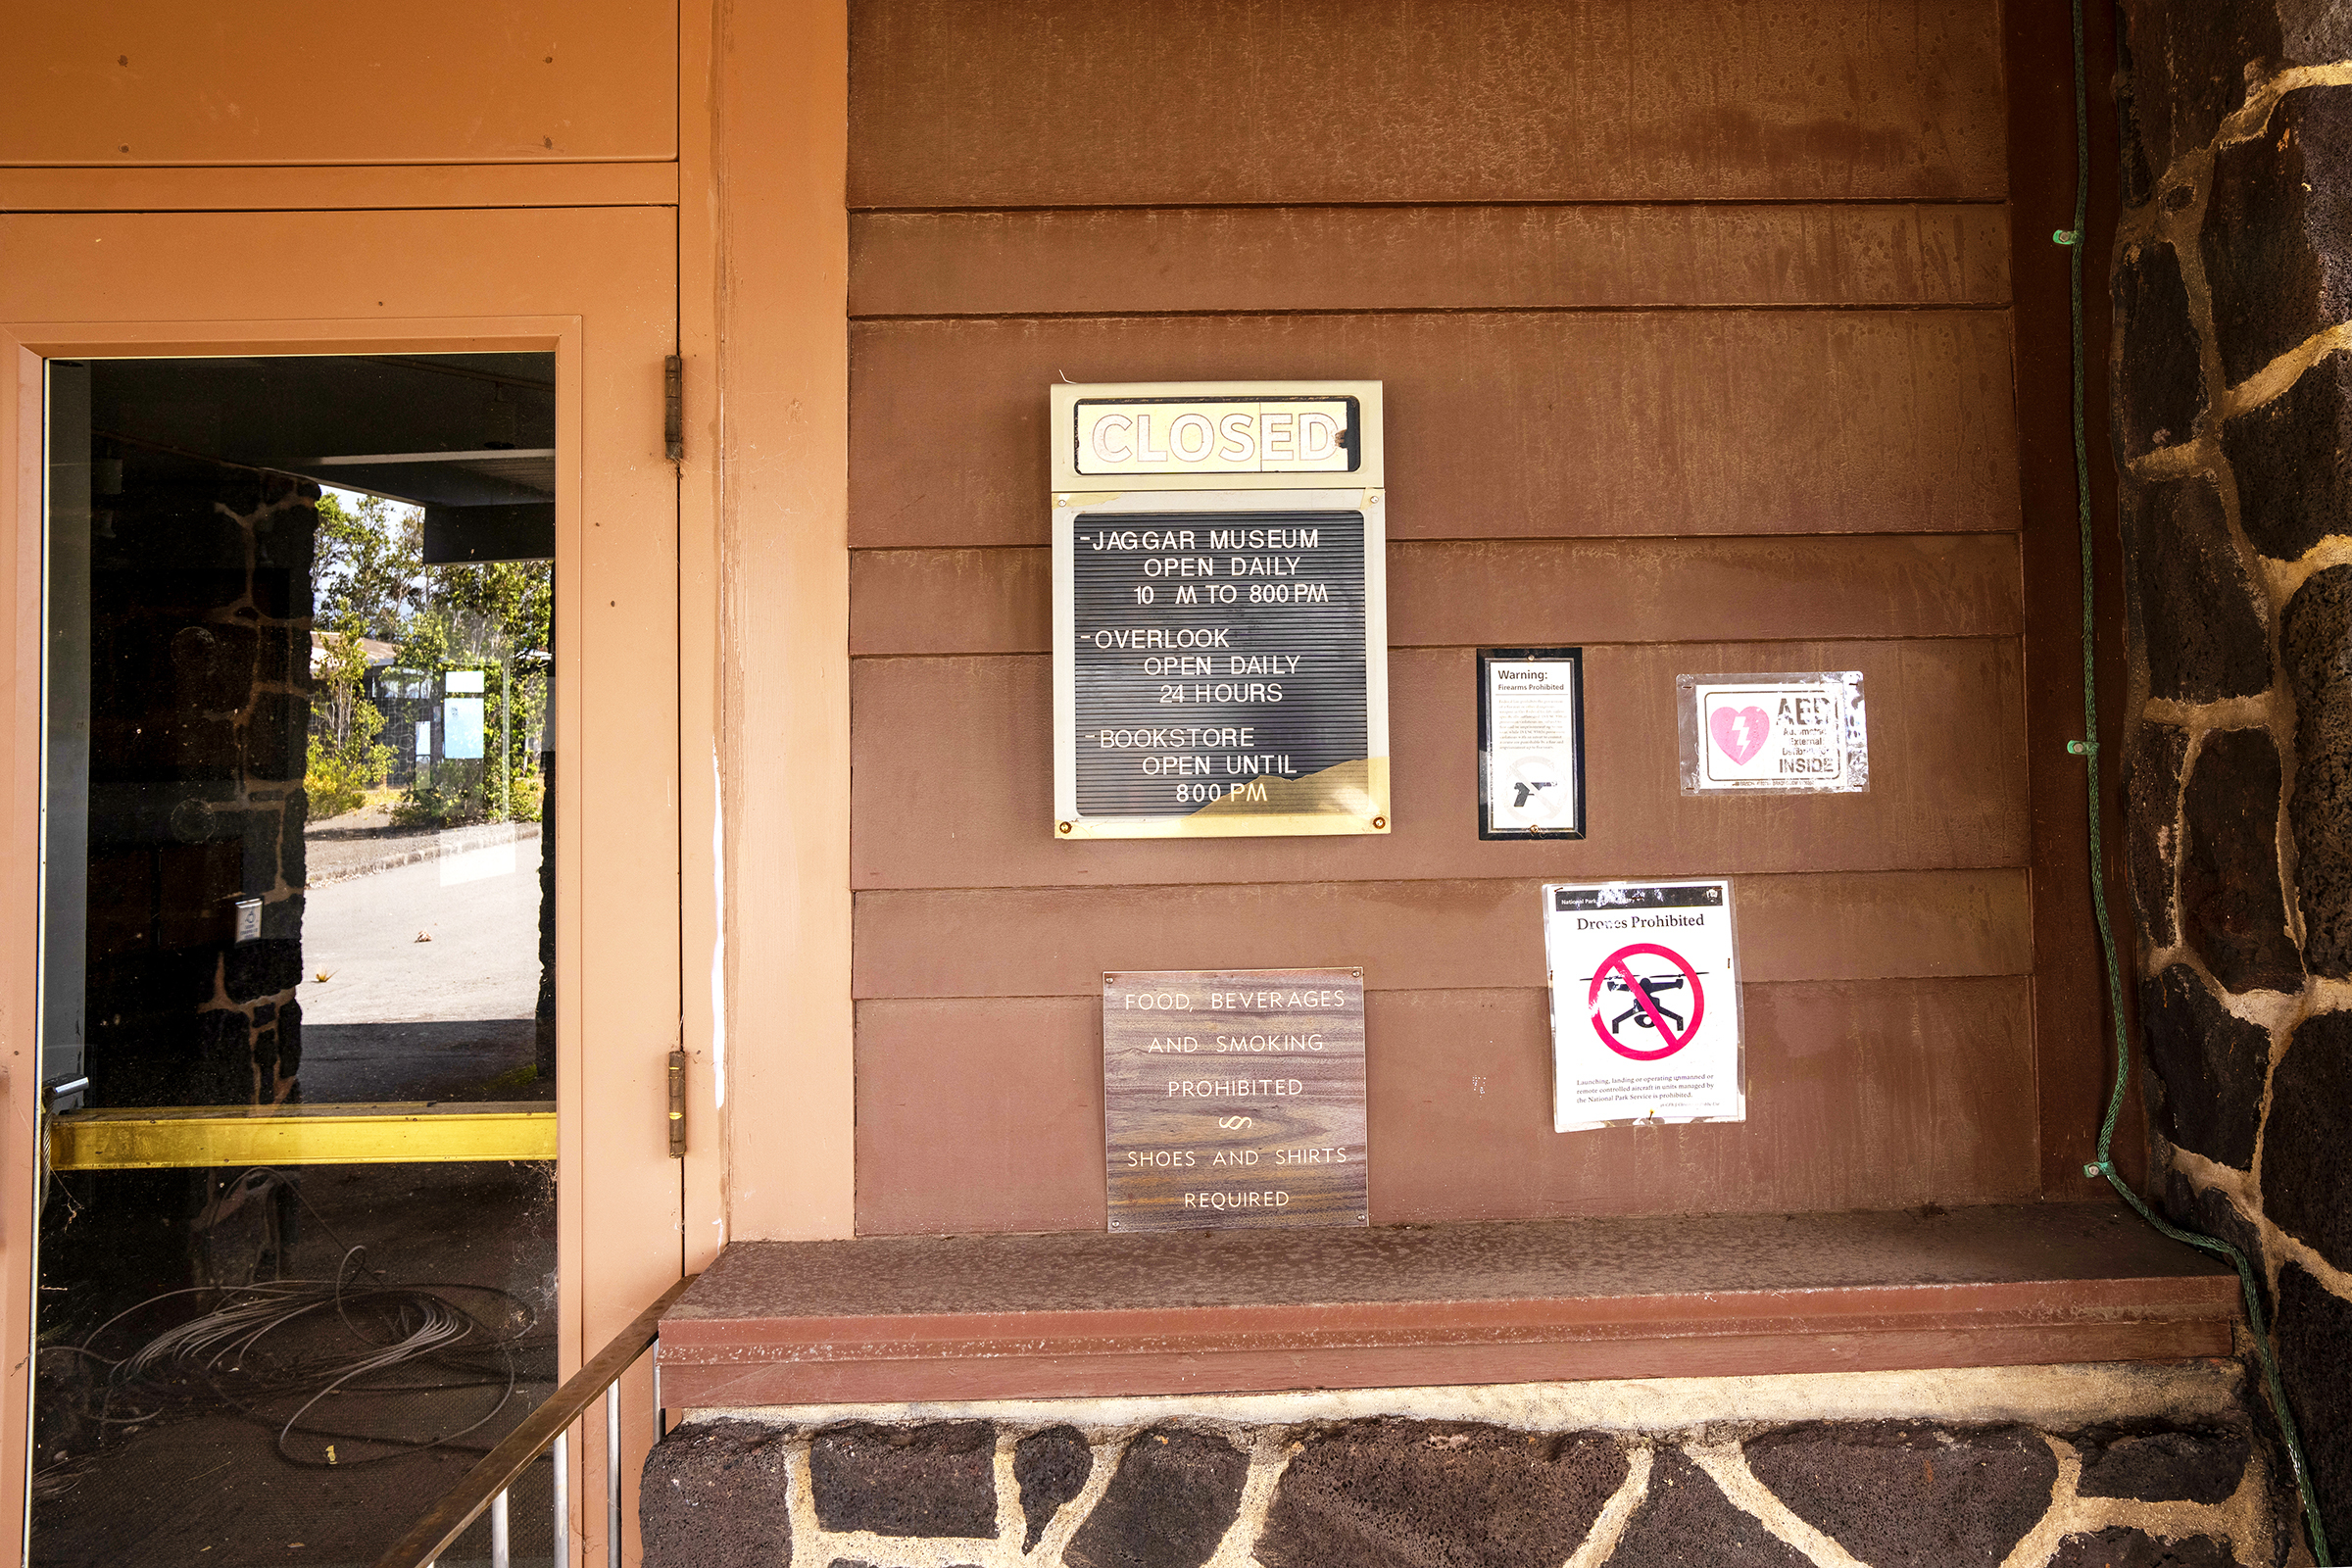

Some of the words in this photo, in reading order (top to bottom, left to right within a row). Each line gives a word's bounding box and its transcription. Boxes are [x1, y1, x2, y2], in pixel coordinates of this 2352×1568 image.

[1092, 413, 1339, 464] CLOSED
[1210, 529, 1319, 550] MUSEUM
[1144, 558, 1213, 577] OPEN
[1231, 556, 1301, 576] DAILY
[1133, 586, 1154, 605] 10
[1205, 584, 1238, 604] TO
[1249, 584, 1289, 604] 800
[1295, 583, 1329, 603] PM
[1144, 657, 1213, 676] OPEN
[1231, 656, 1301, 675] DAILY
[1498, 669, 1547, 682] Warning:
[1159, 685, 1185, 704] 24
[1195, 683, 1283, 703] HOURS
[1143, 757, 1210, 775] OPEN
[1226, 755, 1297, 774] UNTIL
[1780, 758, 1834, 773] INSIDE
[1176, 784, 1221, 803] 800
[1231, 782, 1268, 802] PM
[1632, 914, 1705, 928] Prohibited
[1125, 993, 1196, 1013] FOOD,
[1211, 990, 1345, 1009] BEVERAGES
[1148, 1036, 1198, 1054] AND
[1216, 1034, 1324, 1053] SMOKING
[1168, 1079, 1303, 1098] PROHIBITED
[1127, 1151, 1196, 1167] SHOES
[1212, 1150, 1259, 1166] AND
[1275, 1147, 1348, 1165] SHIRTS
[1185, 1191, 1290, 1211] REQUIRED
